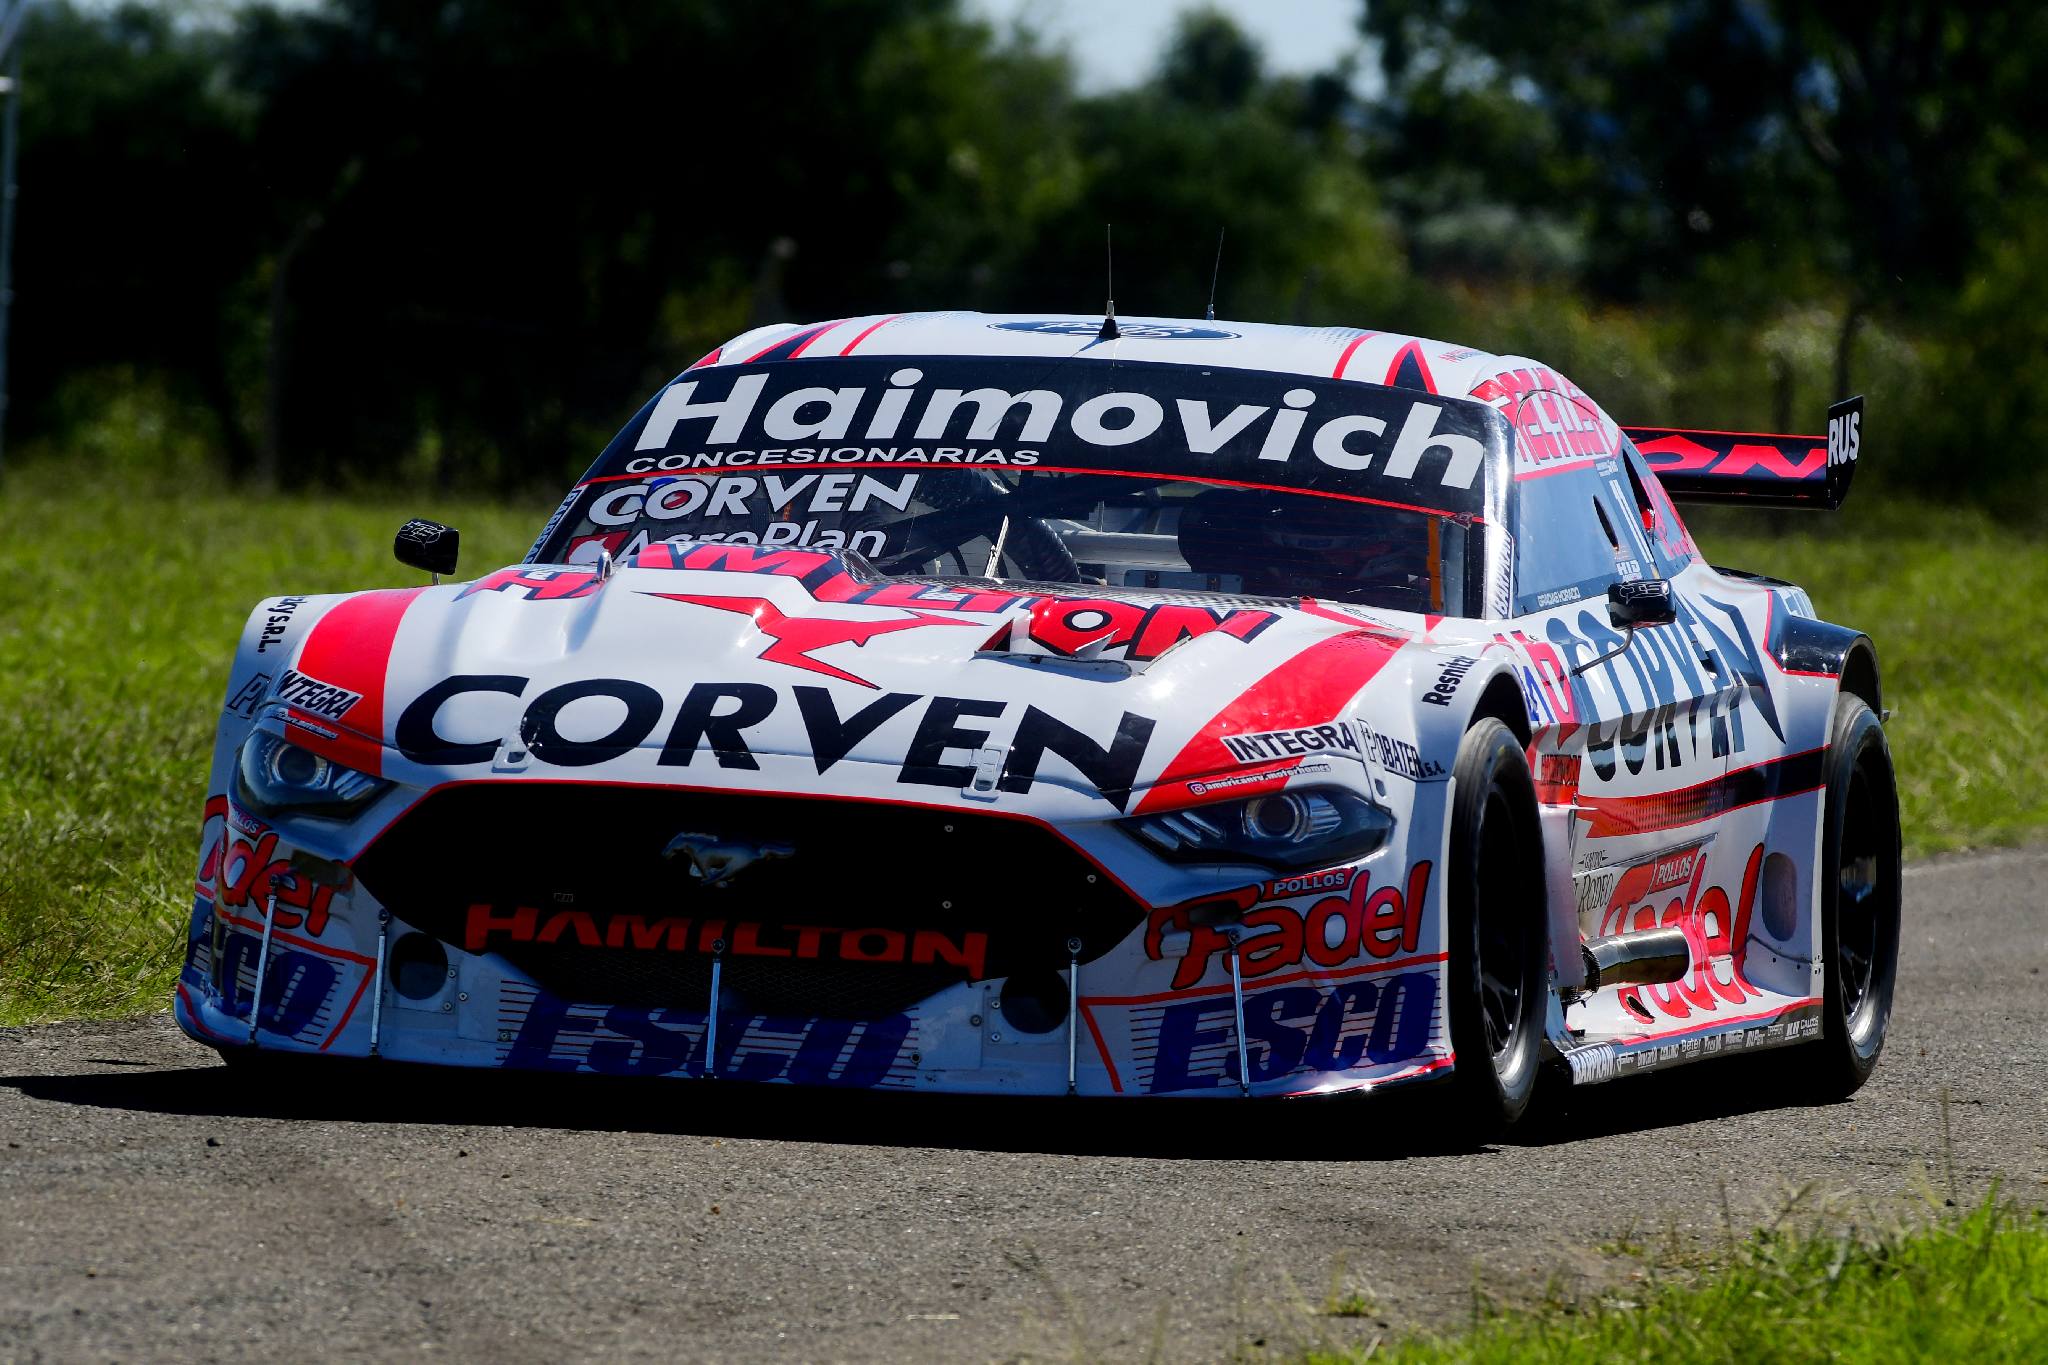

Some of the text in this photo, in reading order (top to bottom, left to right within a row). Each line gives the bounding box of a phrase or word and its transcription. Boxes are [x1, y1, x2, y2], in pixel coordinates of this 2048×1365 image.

[634, 367, 1485, 490] Haimovich
[1828, 411, 1860, 468] RUS
[625, 446, 1040, 474] CONCESIONARIAS
[588, 473, 920, 527] CORVEN
[394, 674, 1158, 816] CORVEN
[1223, 722, 1361, 763] INTEGRA
[1274, 872, 1345, 895] POLLOS
[1656, 856, 1692, 886] POLLOS
[465, 903, 988, 979] HAMILTON
[1148, 971, 1438, 1094] ESCO
